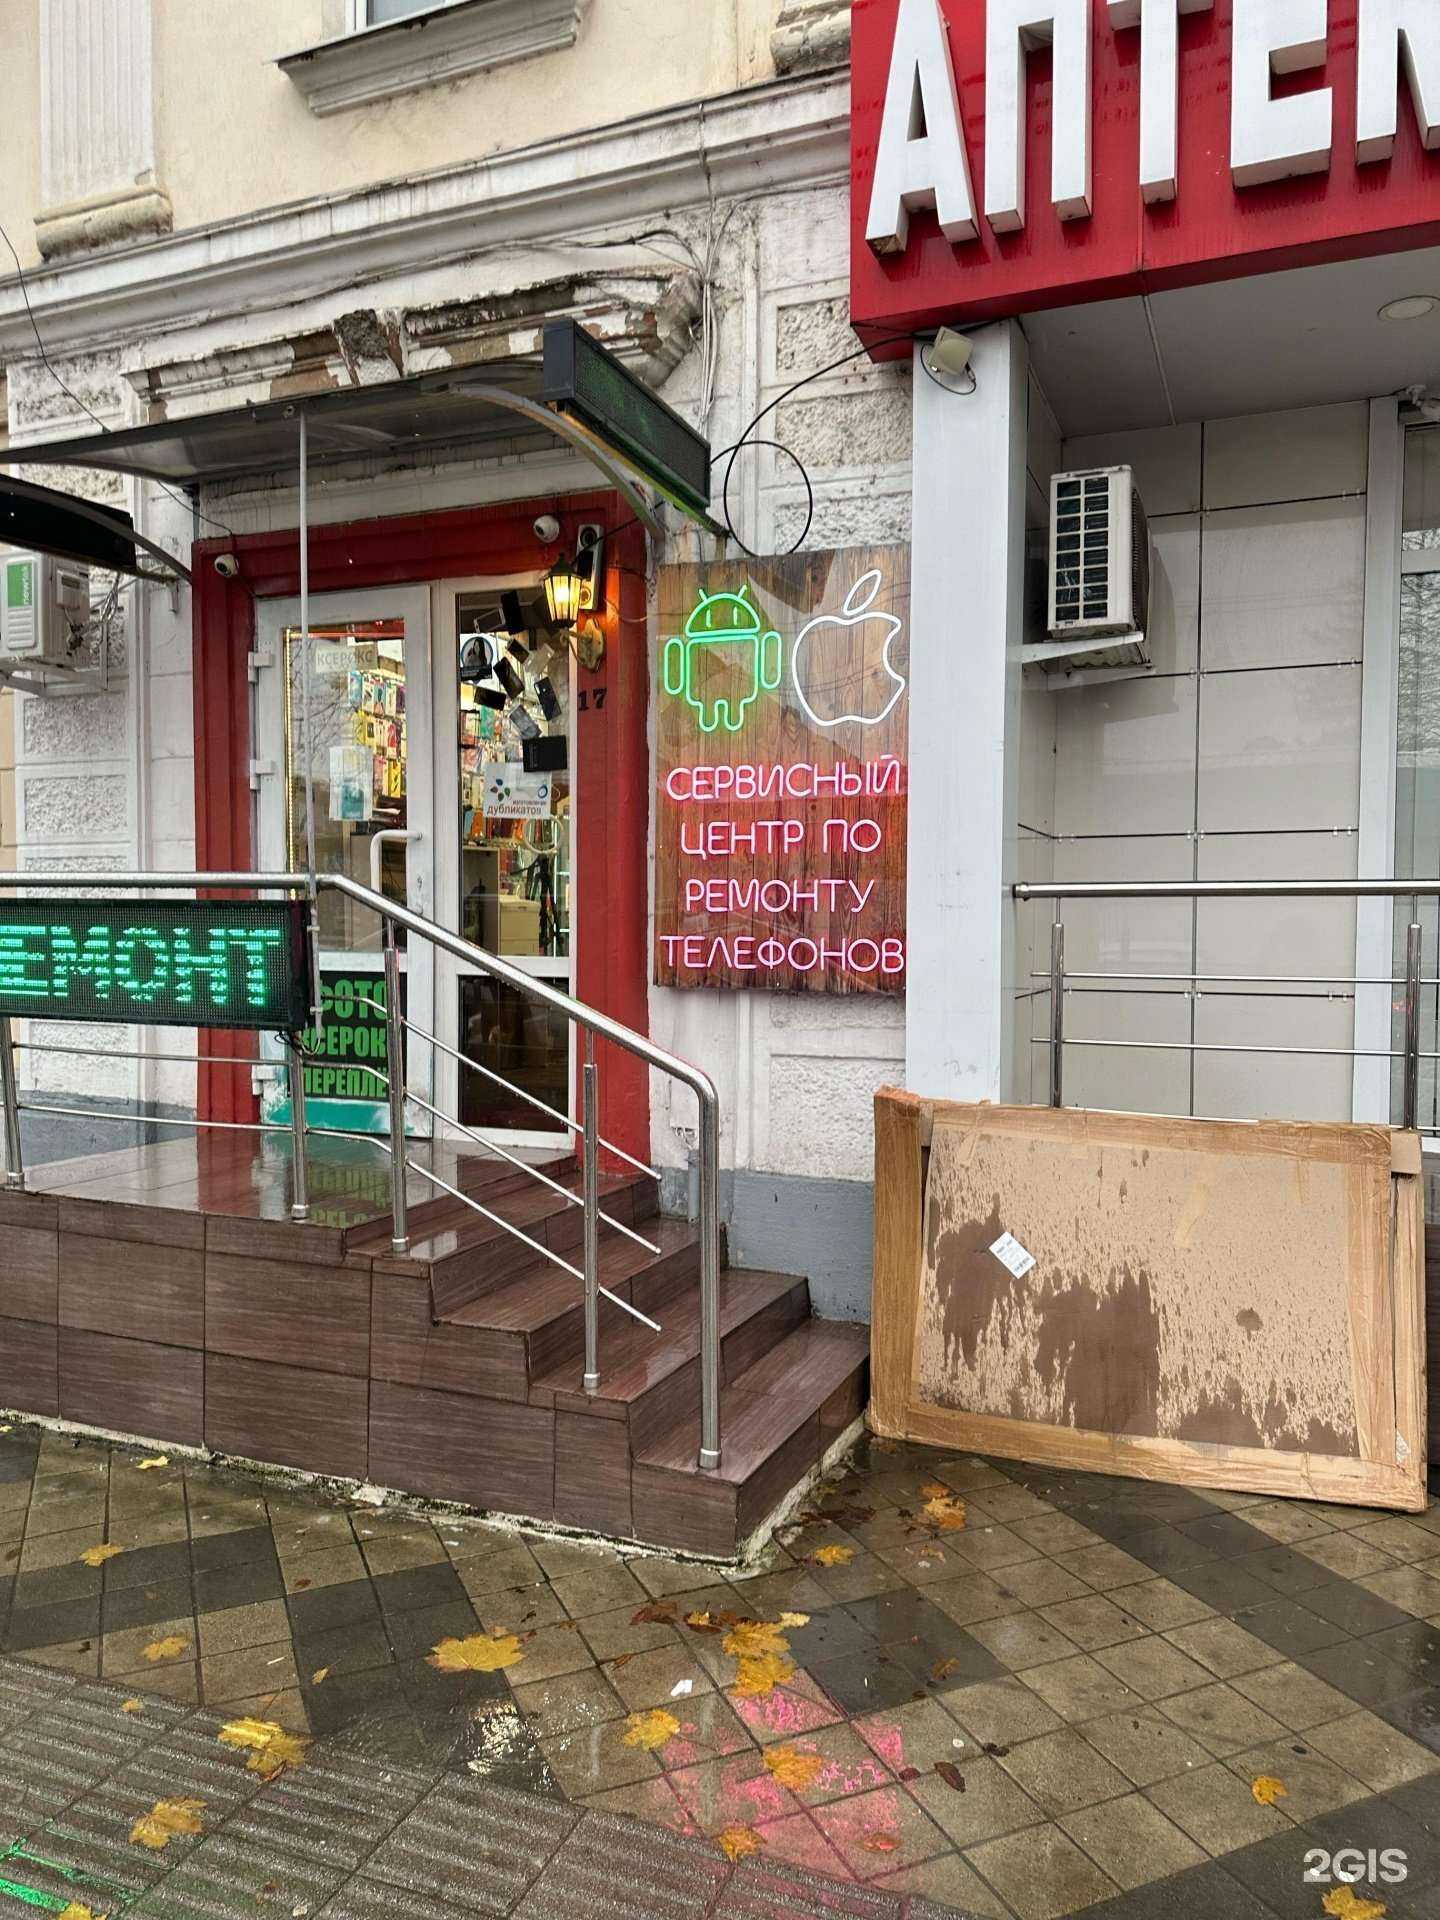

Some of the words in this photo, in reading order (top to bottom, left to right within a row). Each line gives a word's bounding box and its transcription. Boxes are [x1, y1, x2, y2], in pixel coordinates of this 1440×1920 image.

[578, 687, 608, 711] 17
[667, 754, 900, 801] СЕРВИСНЫЙ
[680, 819, 804, 861] ЦЕНТР
[821, 818, 882, 853] ПО
[685, 878, 875, 913] РЕМОНТУ
[659, 934, 904, 974] ТЕЛЕФОНОВ
[303, 1066, 388, 1097] ПЕРЕПЛЁ
